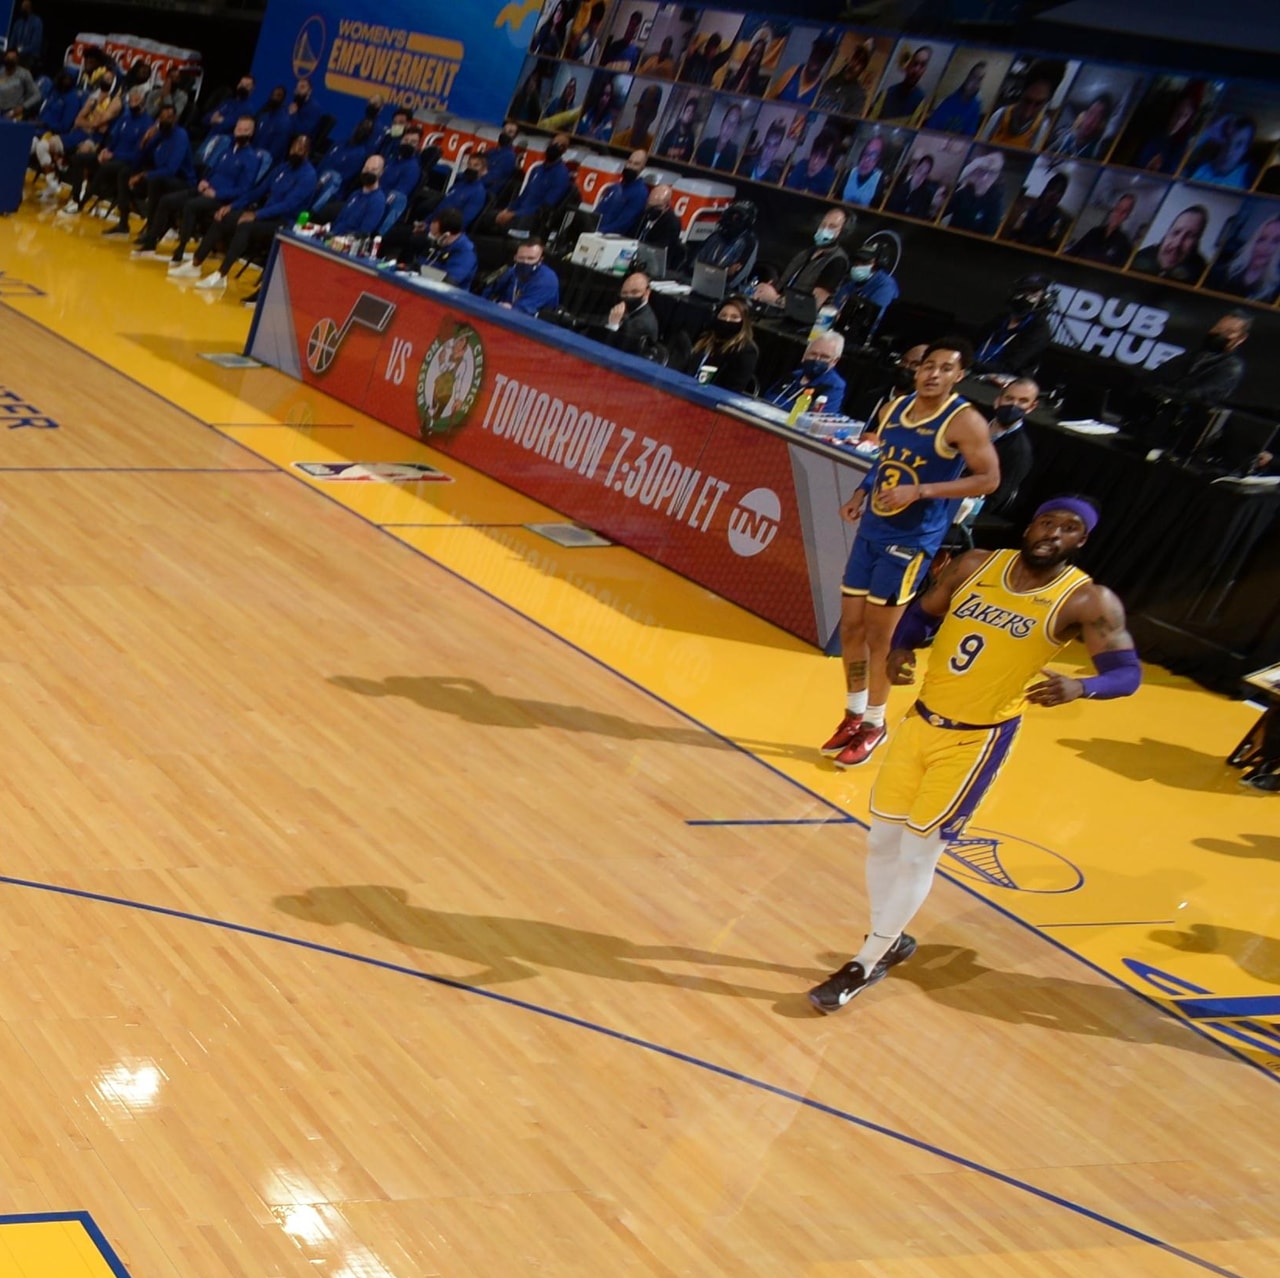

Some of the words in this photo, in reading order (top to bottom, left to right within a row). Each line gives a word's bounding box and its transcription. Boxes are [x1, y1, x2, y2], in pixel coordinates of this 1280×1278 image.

[339, 18, 408, 49] WOMEN'S
[328, 37, 462, 97] EMPOWERMENT
[390, 89, 449, 112] MONTH
[583, 172, 598, 192] G
[674, 196, 690, 217] G
[1064, 289, 1170, 338] DUB
[385, 337, 412, 385] VS
[482, 373, 616, 479] TOMORROW
[604, 427, 701, 521] 7:30PM
[688, 475, 730, 533] ET
[881, 468, 901, 490] 3
[951, 592, 1037, 639] LAKERS
[948, 633, 986, 675] 9
